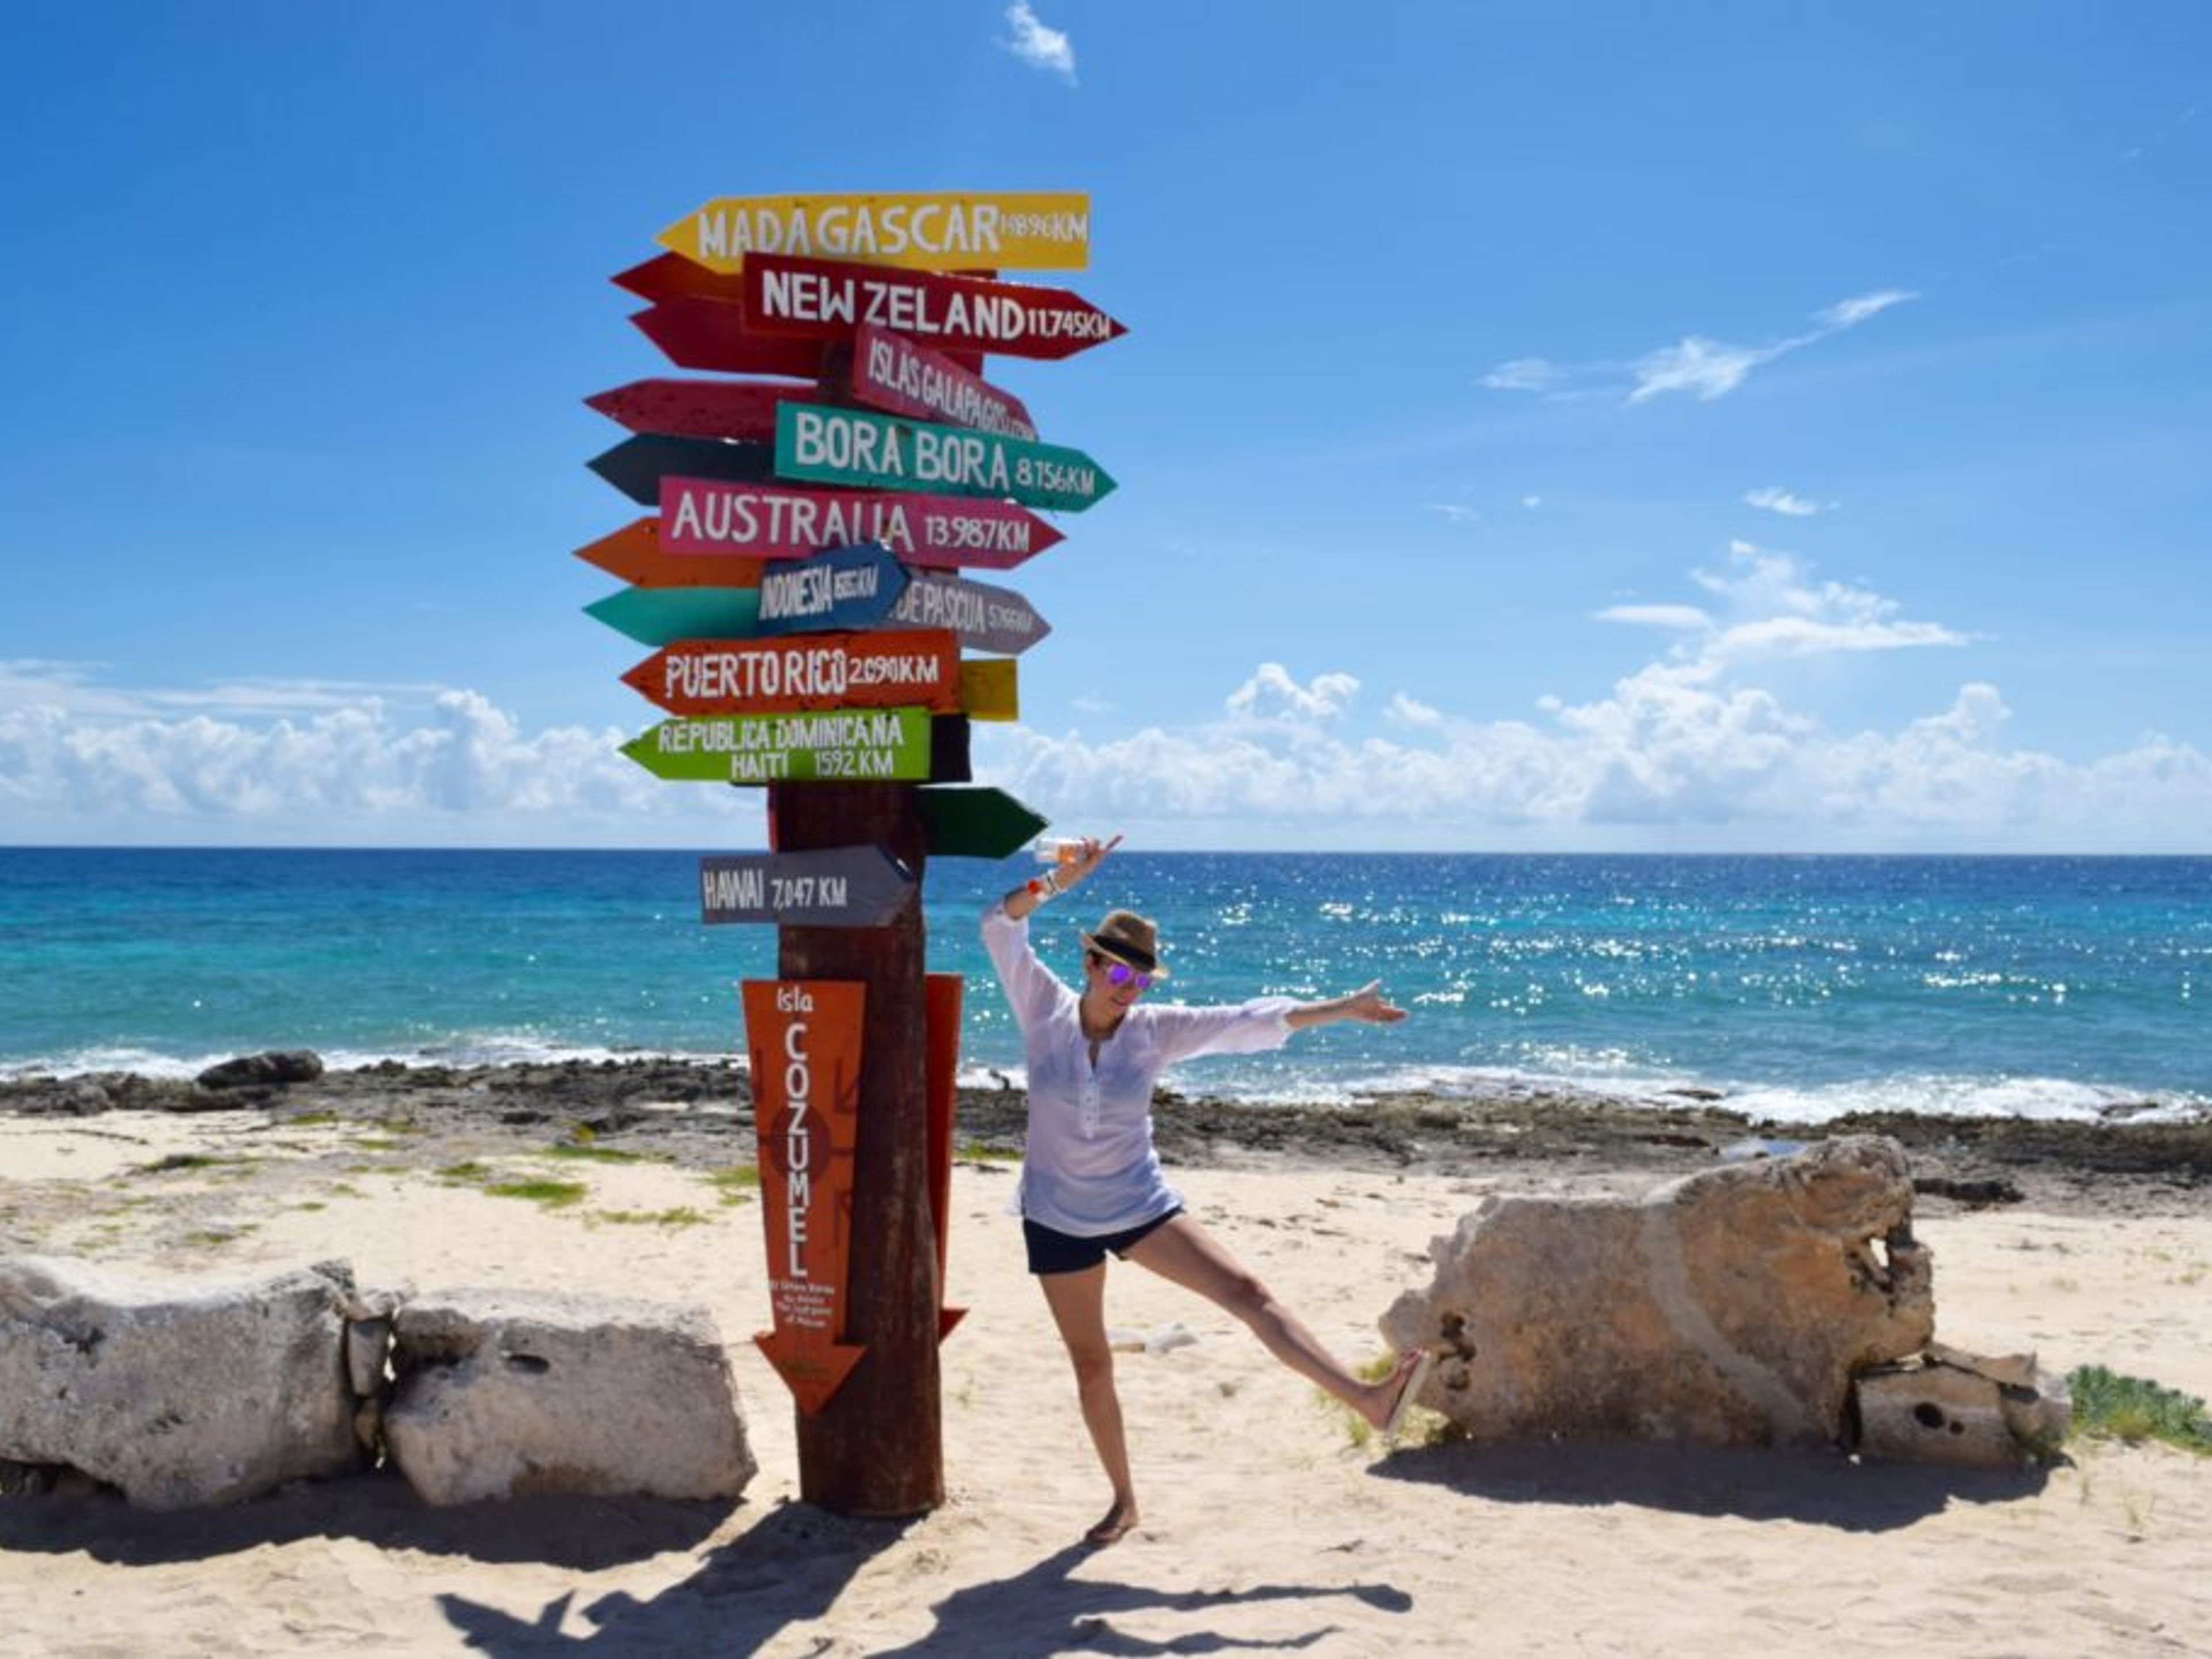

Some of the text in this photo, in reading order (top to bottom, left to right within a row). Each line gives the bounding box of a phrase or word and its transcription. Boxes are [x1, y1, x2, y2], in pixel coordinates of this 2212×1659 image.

[697, 204, 1000, 257] MADAGASCAR
[762, 270, 855, 324] NEW
[864, 282, 1026, 340] ZELAND
[869, 336, 921, 400] ISLAS
[795, 411, 903, 477] BORA
[914, 432, 1010, 491] BORA
[671, 491, 1029, 552] AUSTRALIA 13.987KM
[923, 583, 986, 633] PASCUA
[665, 652, 780, 699] PUERTO
[785, 649, 847, 697] RICO
[658, 714, 904, 753] REPUBLICA DOMINICANA
[814, 749, 856, 777] 1592
[859, 749, 894, 776] KM
[702, 869, 764, 909] HAWAI
[819, 876, 848, 907] KM
[776, 984, 813, 1013] Isla
[785, 1023, 810, 1277] COZUMEL
